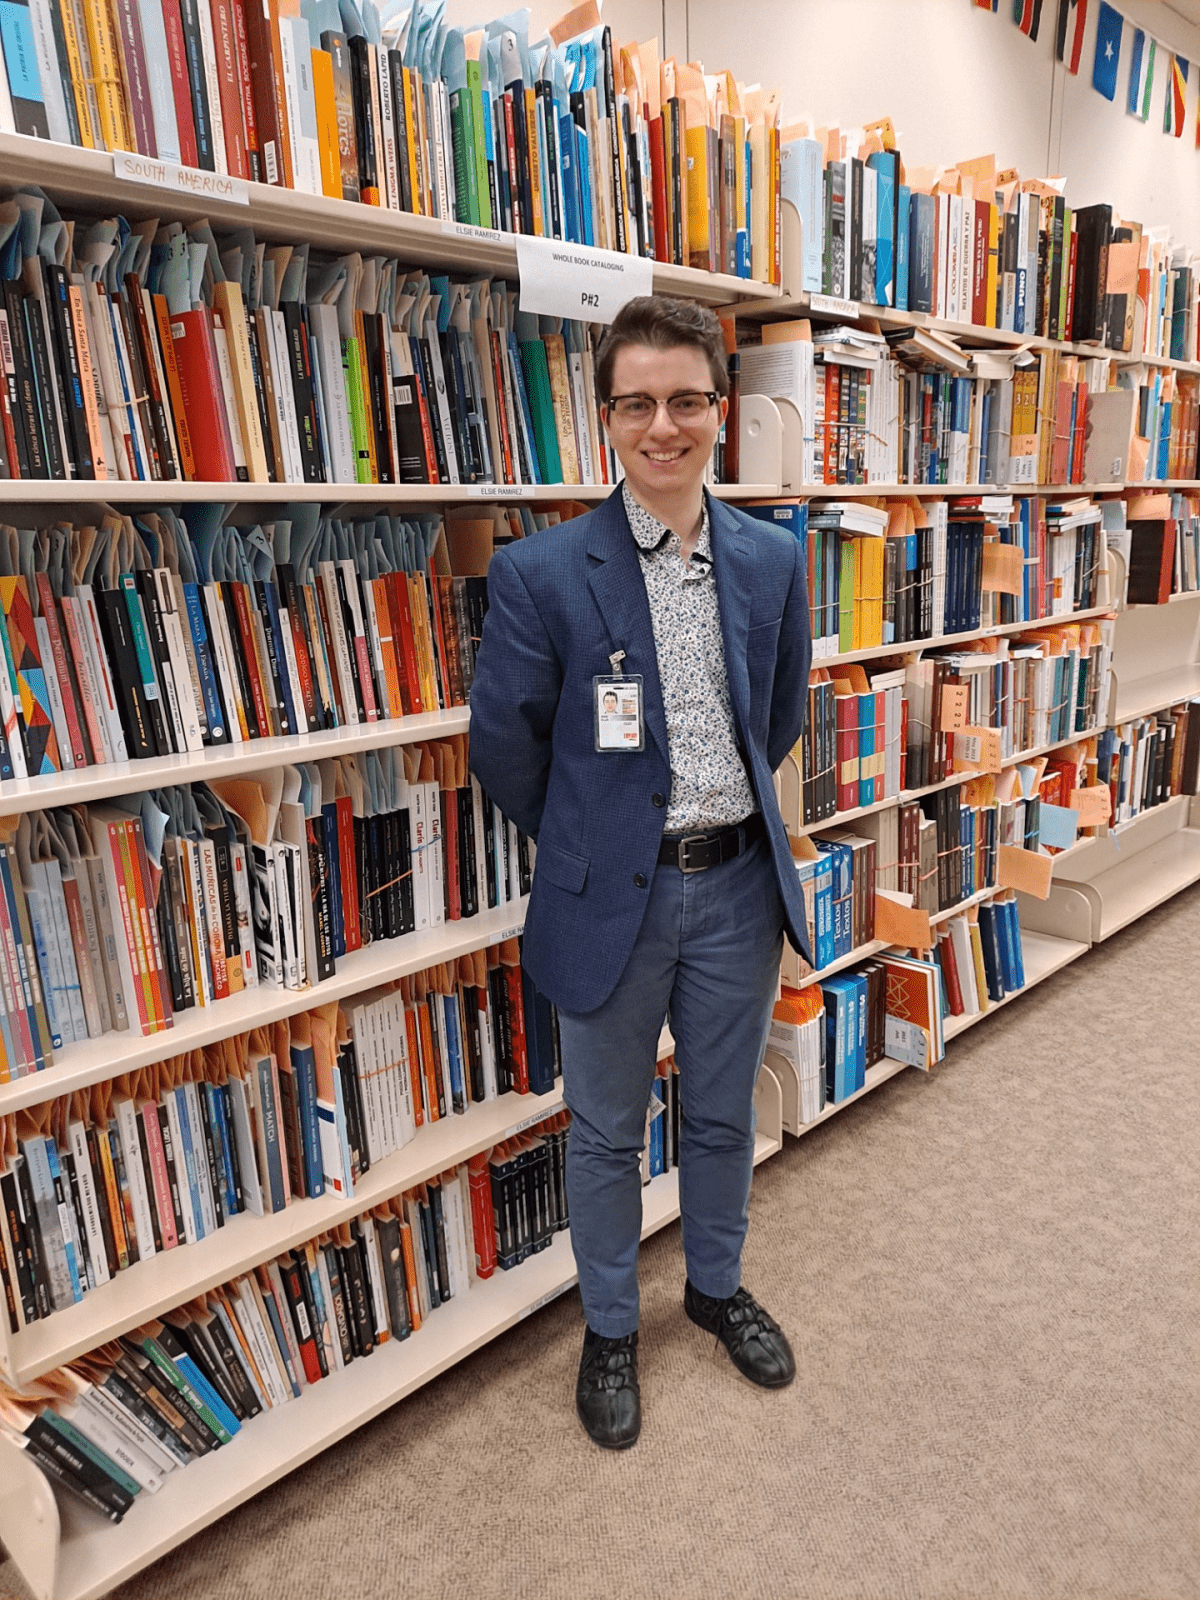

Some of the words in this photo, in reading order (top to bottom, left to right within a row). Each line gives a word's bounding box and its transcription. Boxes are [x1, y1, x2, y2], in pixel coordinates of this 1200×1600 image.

[219, 5, 233, 69] CARPINTERO
[226, 71, 234, 83] EL
[381, 54, 389, 79] LAPID
[383, 81, 392, 120] ROBERTO
[124, 160, 166, 182] SOUTH
[178, 172, 233, 195] AMERICA
[389, 166, 397, 199] ENIGMA
[613, 158, 624, 212] ARQUEOLÓGICA
[392, 199, 398, 209] EL
[456, 227, 474, 236] ELSIE
[616, 214, 626, 250] CERÁMICA
[963, 234, 971, 264] GUERRA
[552, 253, 573, 264] WHOLE
[574, 256, 590, 267] BOOK
[590, 258, 625, 272] CATALOGING
[962, 266, 969, 276] DE
[961, 278, 969, 310] RELATOS
[1018, 271, 1026, 307] PUNO
[581, 293, 599, 308] P#2
[78, 329, 87, 348] Santa
[80, 351, 90, 372] Marta
[23, 380, 33, 401] deseo
[29, 417, 37, 436] letras
[31, 438, 39, 453] cinco
[582, 432, 590, 461] Completas
[33, 455, 41, 467] Las
[338, 629, 346, 646] SERES
[298, 650, 308, 678] CÓDIGO
[359, 644, 369, 673] CAROLINA
[302, 679, 313, 708] SECRETO
[416, 821, 425, 844] Clarín
[203, 849, 213, 865] LAS
[206, 866, 218, 905] MUÑECAS
[211, 904, 217, 912] de
[212, 913, 218, 921] la
[226, 903, 232, 912] LA
[226, 913, 234, 940] DEJARÁS
[833, 904, 841, 943] Textos
[843, 900, 851, 939] Textos
[211, 922, 223, 956] CORONA
[502, 929, 517, 939] ELSIE
[179, 947, 188, 963] Inés
[181, 964, 189, 974] de
[214, 959, 223, 991] PACHECO
[183, 975, 192, 988] hija
[184, 988, 192, 999] La
[162, 1126, 171, 1143] LOCAL
[266, 1111, 275, 1143] MATCH
[516, 1121, 531, 1132] ELSIE
[165, 1144, 174, 1161] FAUNA
